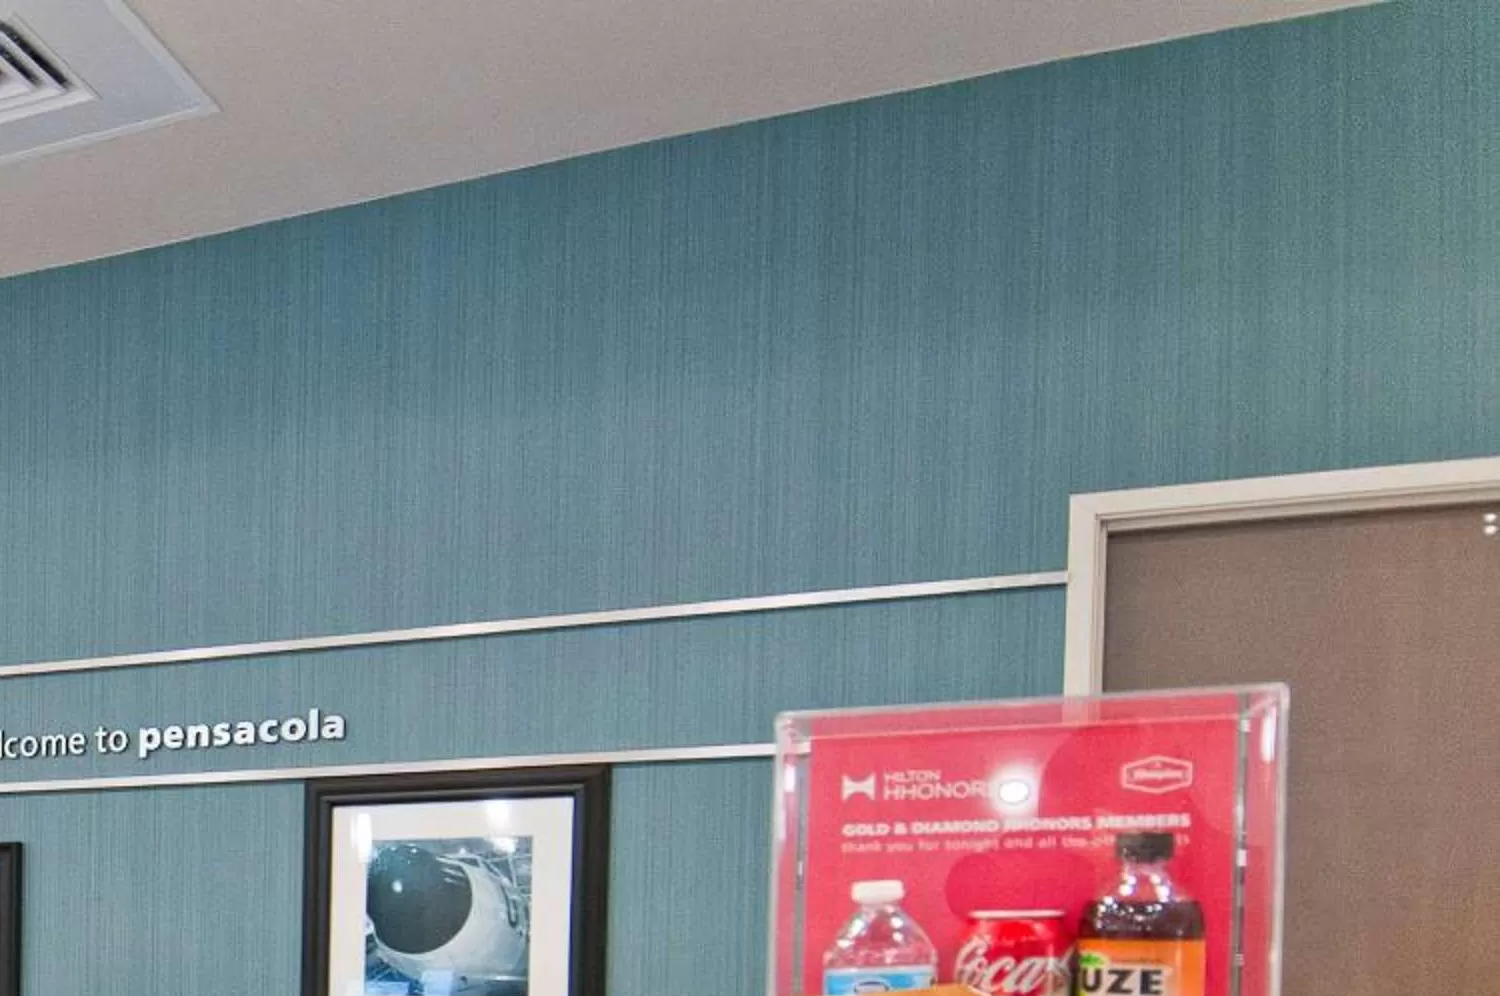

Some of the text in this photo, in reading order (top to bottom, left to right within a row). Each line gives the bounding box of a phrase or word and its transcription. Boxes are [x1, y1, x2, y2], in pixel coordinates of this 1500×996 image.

[96, 725, 129, 754] to
[138, 707, 348, 759] pensacola
[883, 769, 941, 782] HILTON
[883, 780, 1001, 800] HHONOR
[842, 822, 891, 837] GOLD
[911, 819, 999, 834] DIAMOND
[1095, 812, 1191, 829] MEMBERS
